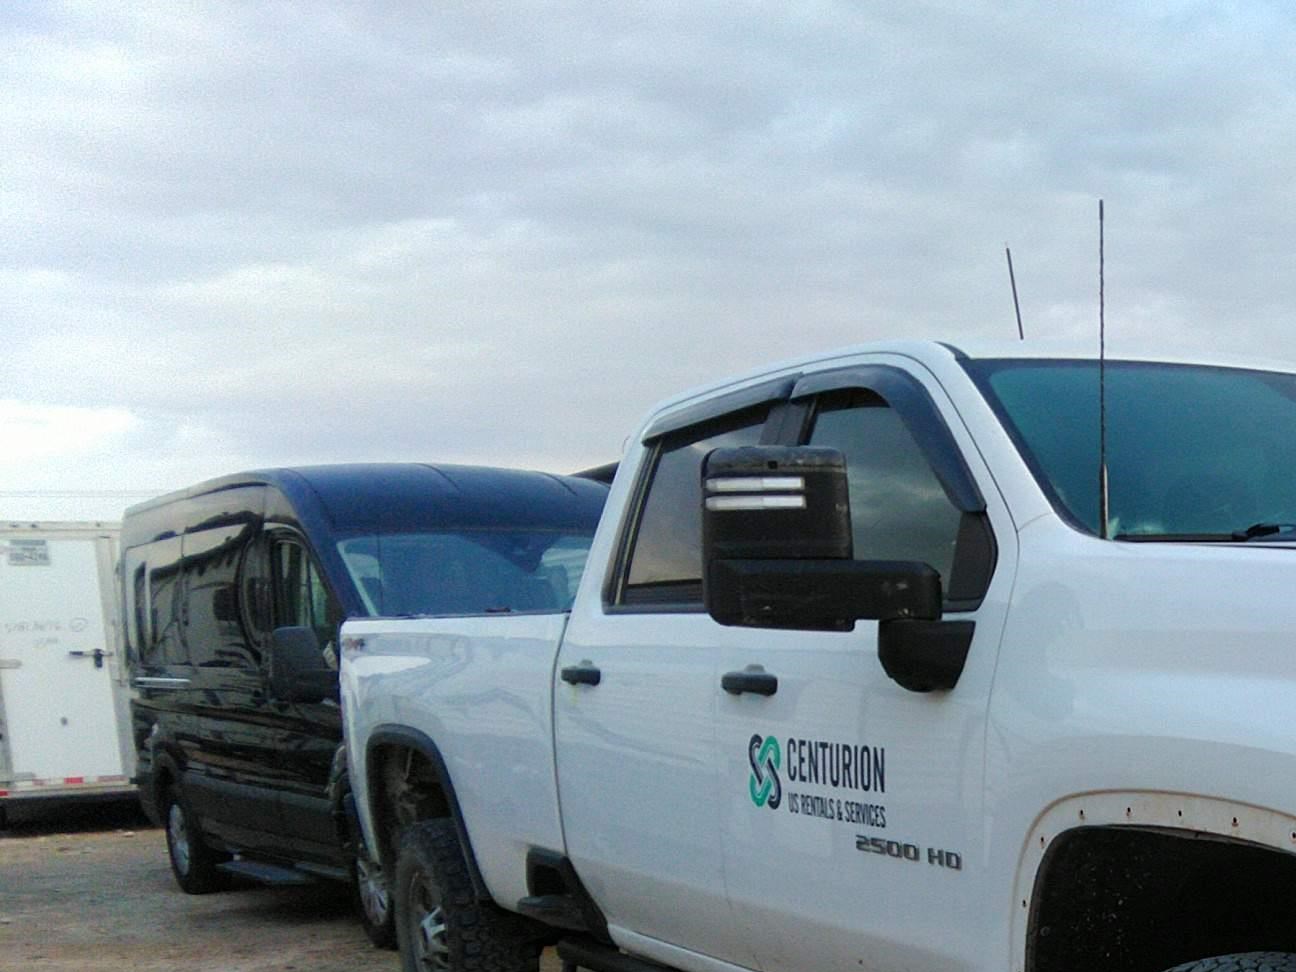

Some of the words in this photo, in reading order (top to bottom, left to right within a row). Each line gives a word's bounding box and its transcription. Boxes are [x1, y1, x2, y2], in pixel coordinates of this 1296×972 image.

[787, 738, 885, 793] CENTURION
[788, 793, 799, 812] US
[801, 794, 835, 820] RENTALS
[836, 801, 844, 821] &
[845, 802, 887, 828] SERVICES
[855, 835, 920, 862] 2500
[928, 848, 962, 871] HD
